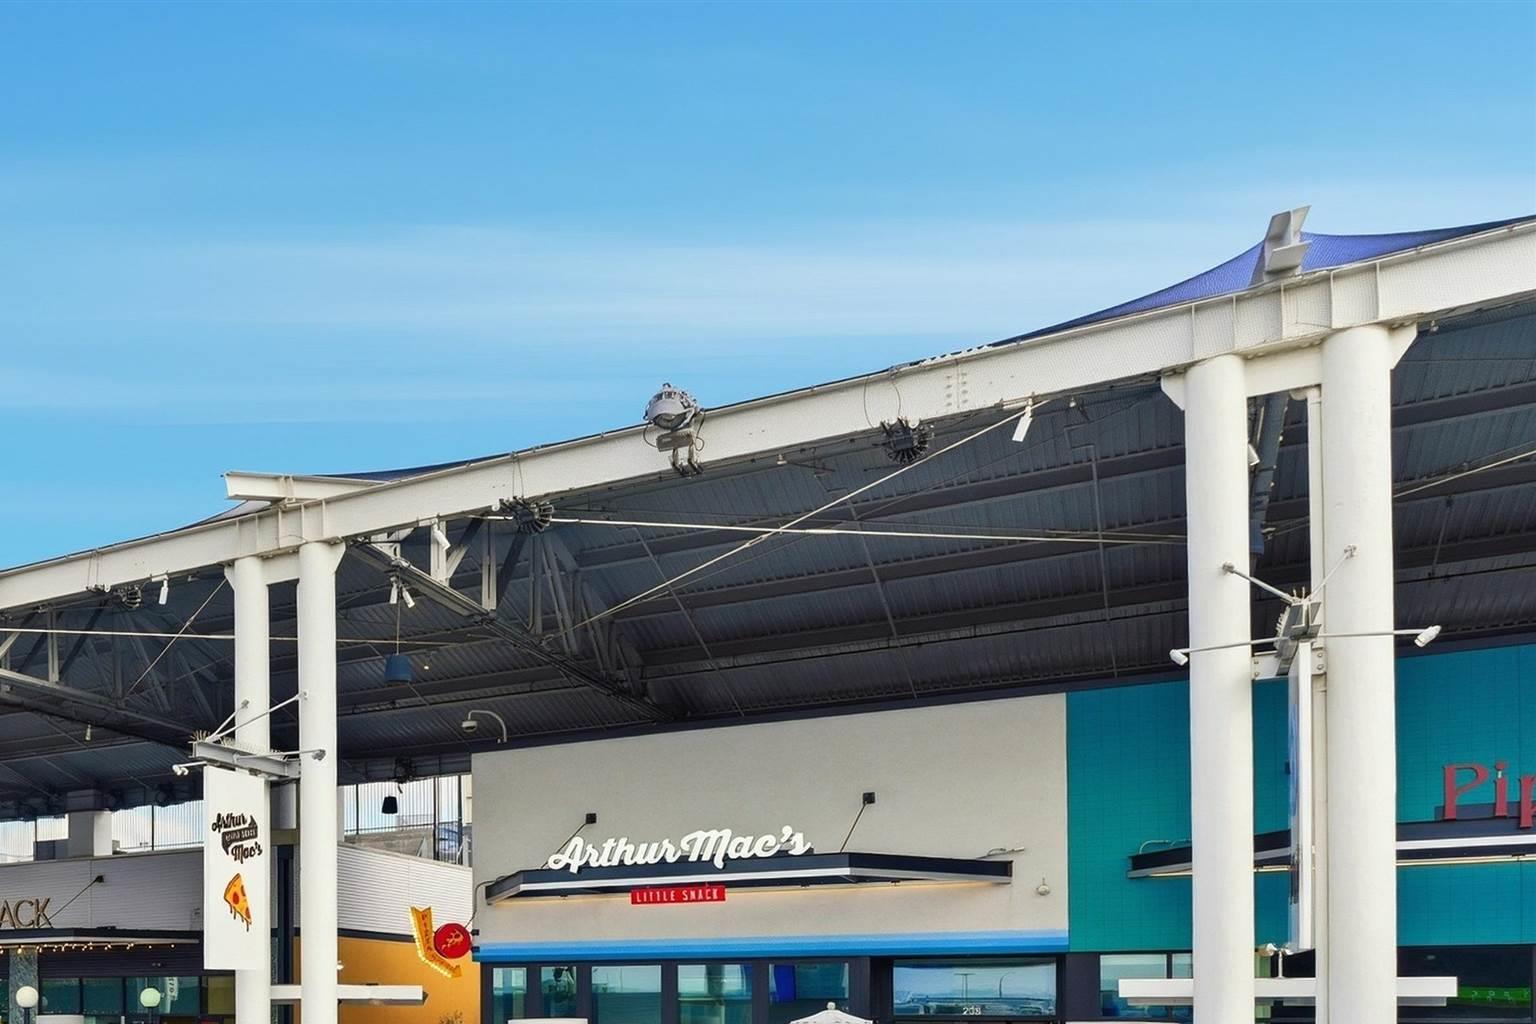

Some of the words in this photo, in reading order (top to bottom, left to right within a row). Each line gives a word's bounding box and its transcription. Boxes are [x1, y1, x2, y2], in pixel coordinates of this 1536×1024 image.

[548, 836, 681, 874] Arthur
[680, 825, 813, 869] Mac's
[636, 890, 676, 903] LITTLE
[682, 886, 719, 901] SNACK
